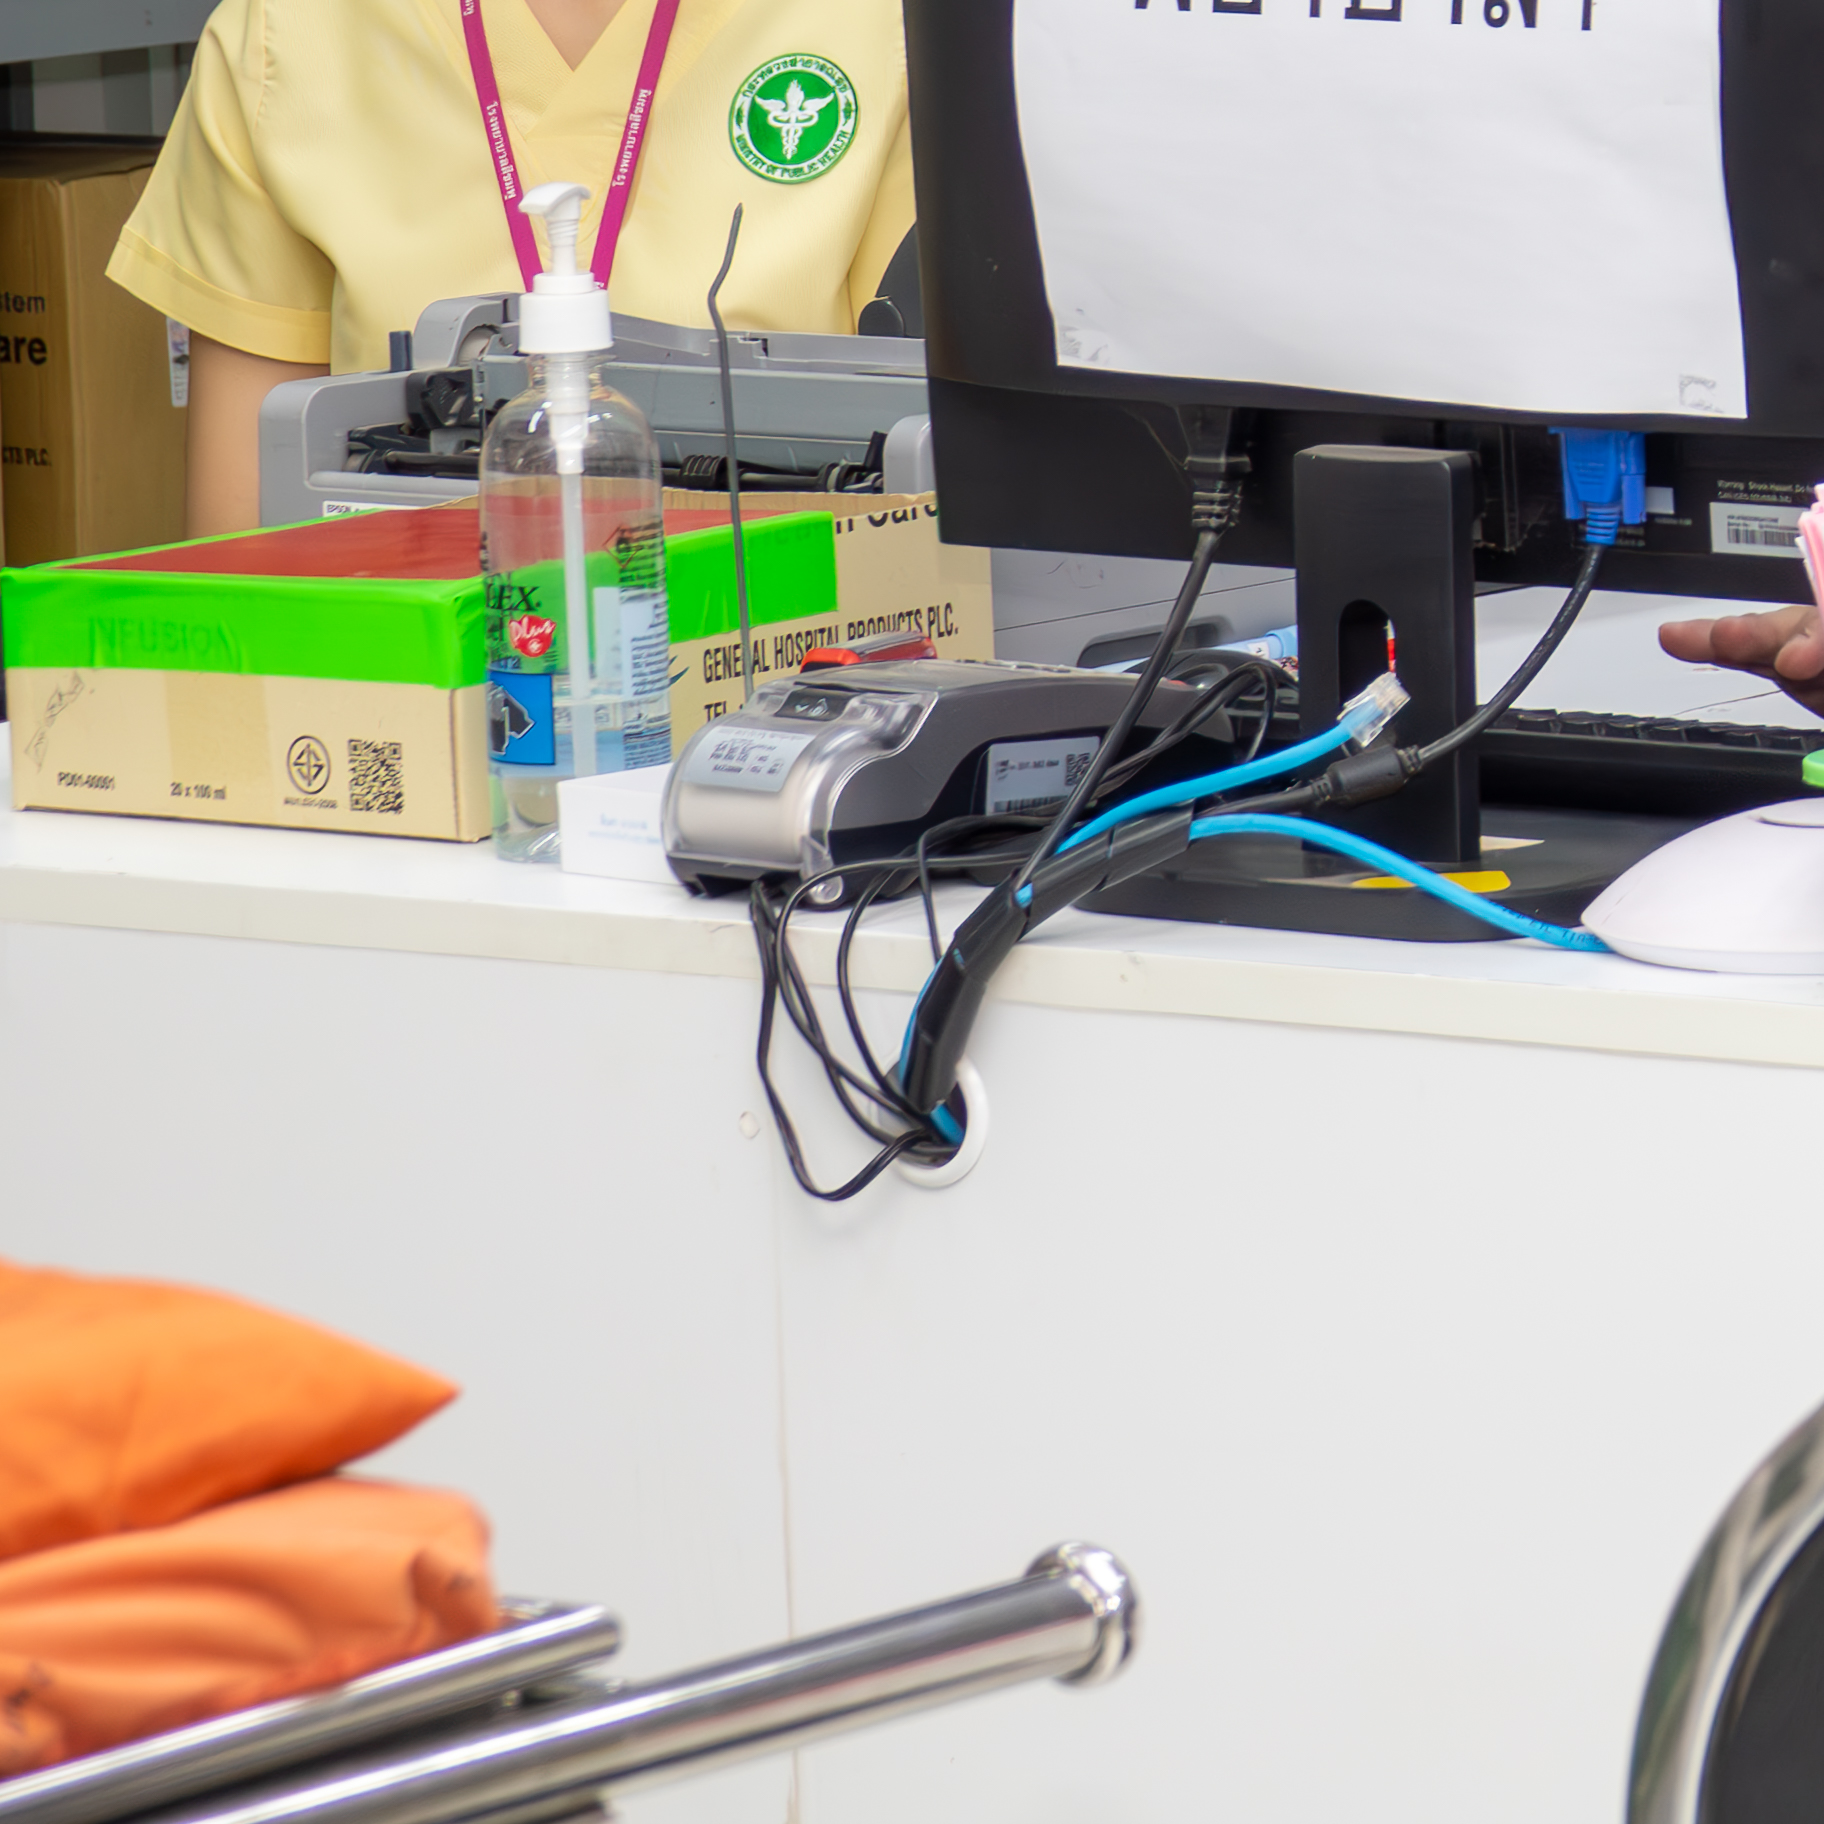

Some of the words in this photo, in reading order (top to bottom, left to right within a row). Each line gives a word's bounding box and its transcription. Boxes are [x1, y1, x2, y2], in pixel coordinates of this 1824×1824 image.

[611, 89, 652, 188] โรงพยาบาลสีชมพู
[703, 636, 770, 684] GENEAL
[927, 602, 959, 639] PLC.
